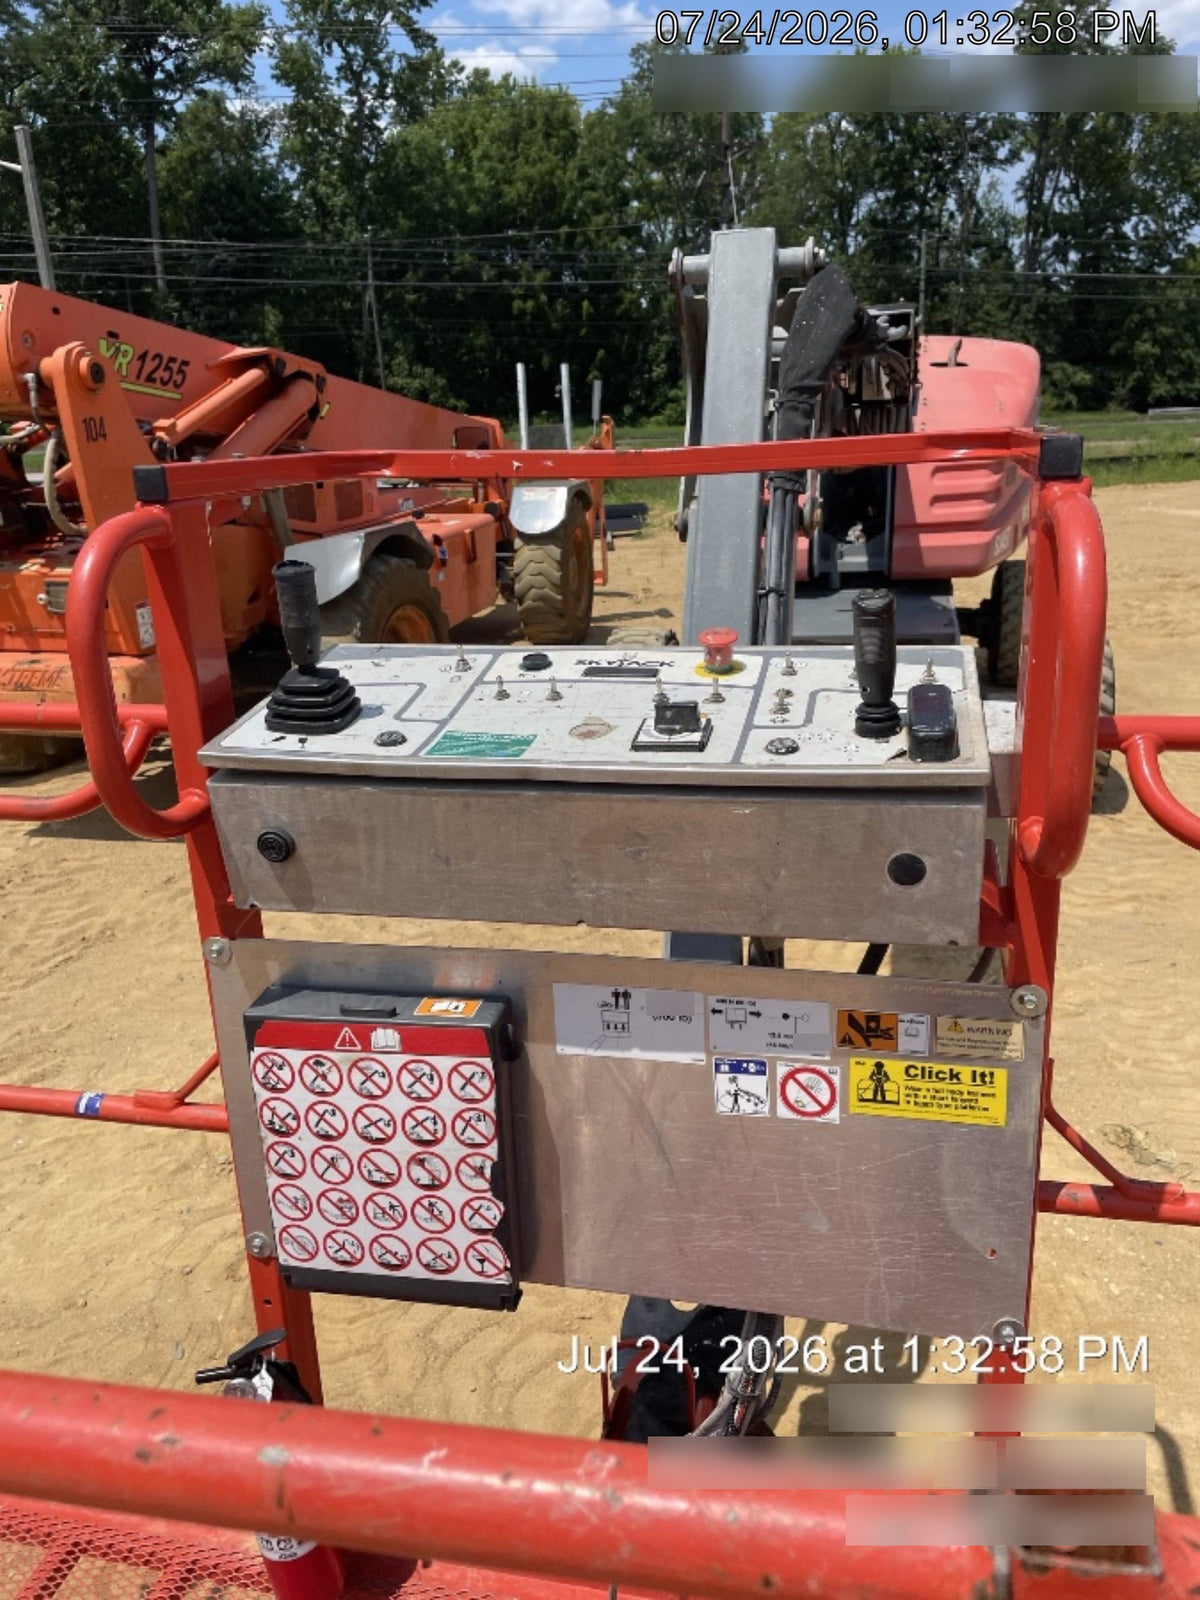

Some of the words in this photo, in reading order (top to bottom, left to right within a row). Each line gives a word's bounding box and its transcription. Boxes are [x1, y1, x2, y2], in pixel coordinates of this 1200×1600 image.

[98, 338, 135, 378] VR
[135, 349, 191, 389] 1255
[83, 416, 107, 442] 104
[574, 659, 675, 667] SKYJACK
[904, 1064, 962, 1082] Click
[971, 1070, 995, 1086] It!
